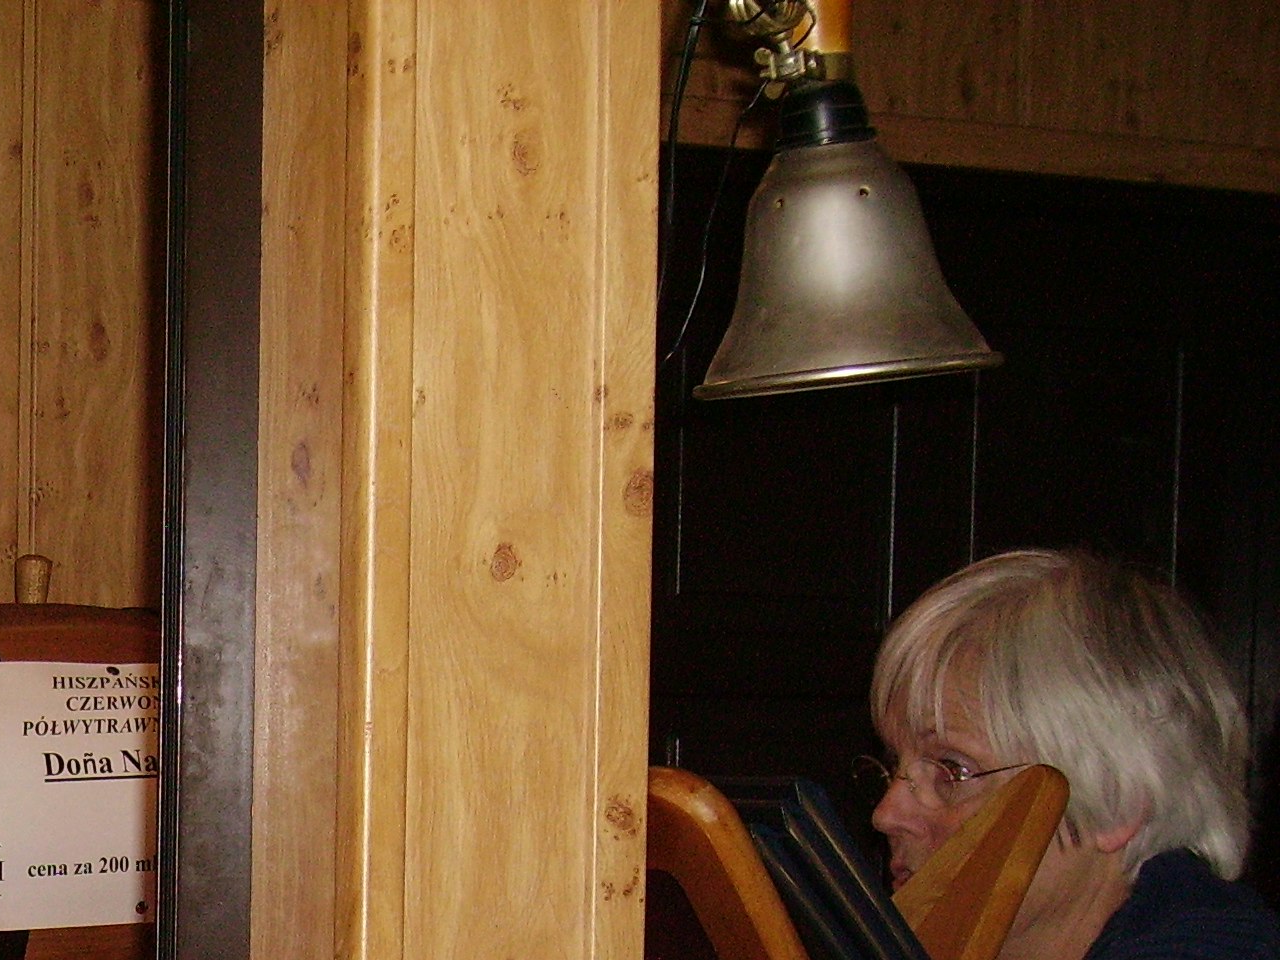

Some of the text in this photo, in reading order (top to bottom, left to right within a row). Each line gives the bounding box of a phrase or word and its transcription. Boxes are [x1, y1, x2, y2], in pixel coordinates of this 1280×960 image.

[42, 752, 114, 777] Doña
[27, 862, 68, 878] cena
[74, 862, 93, 875] za
[99, 856, 130, 874] 200
